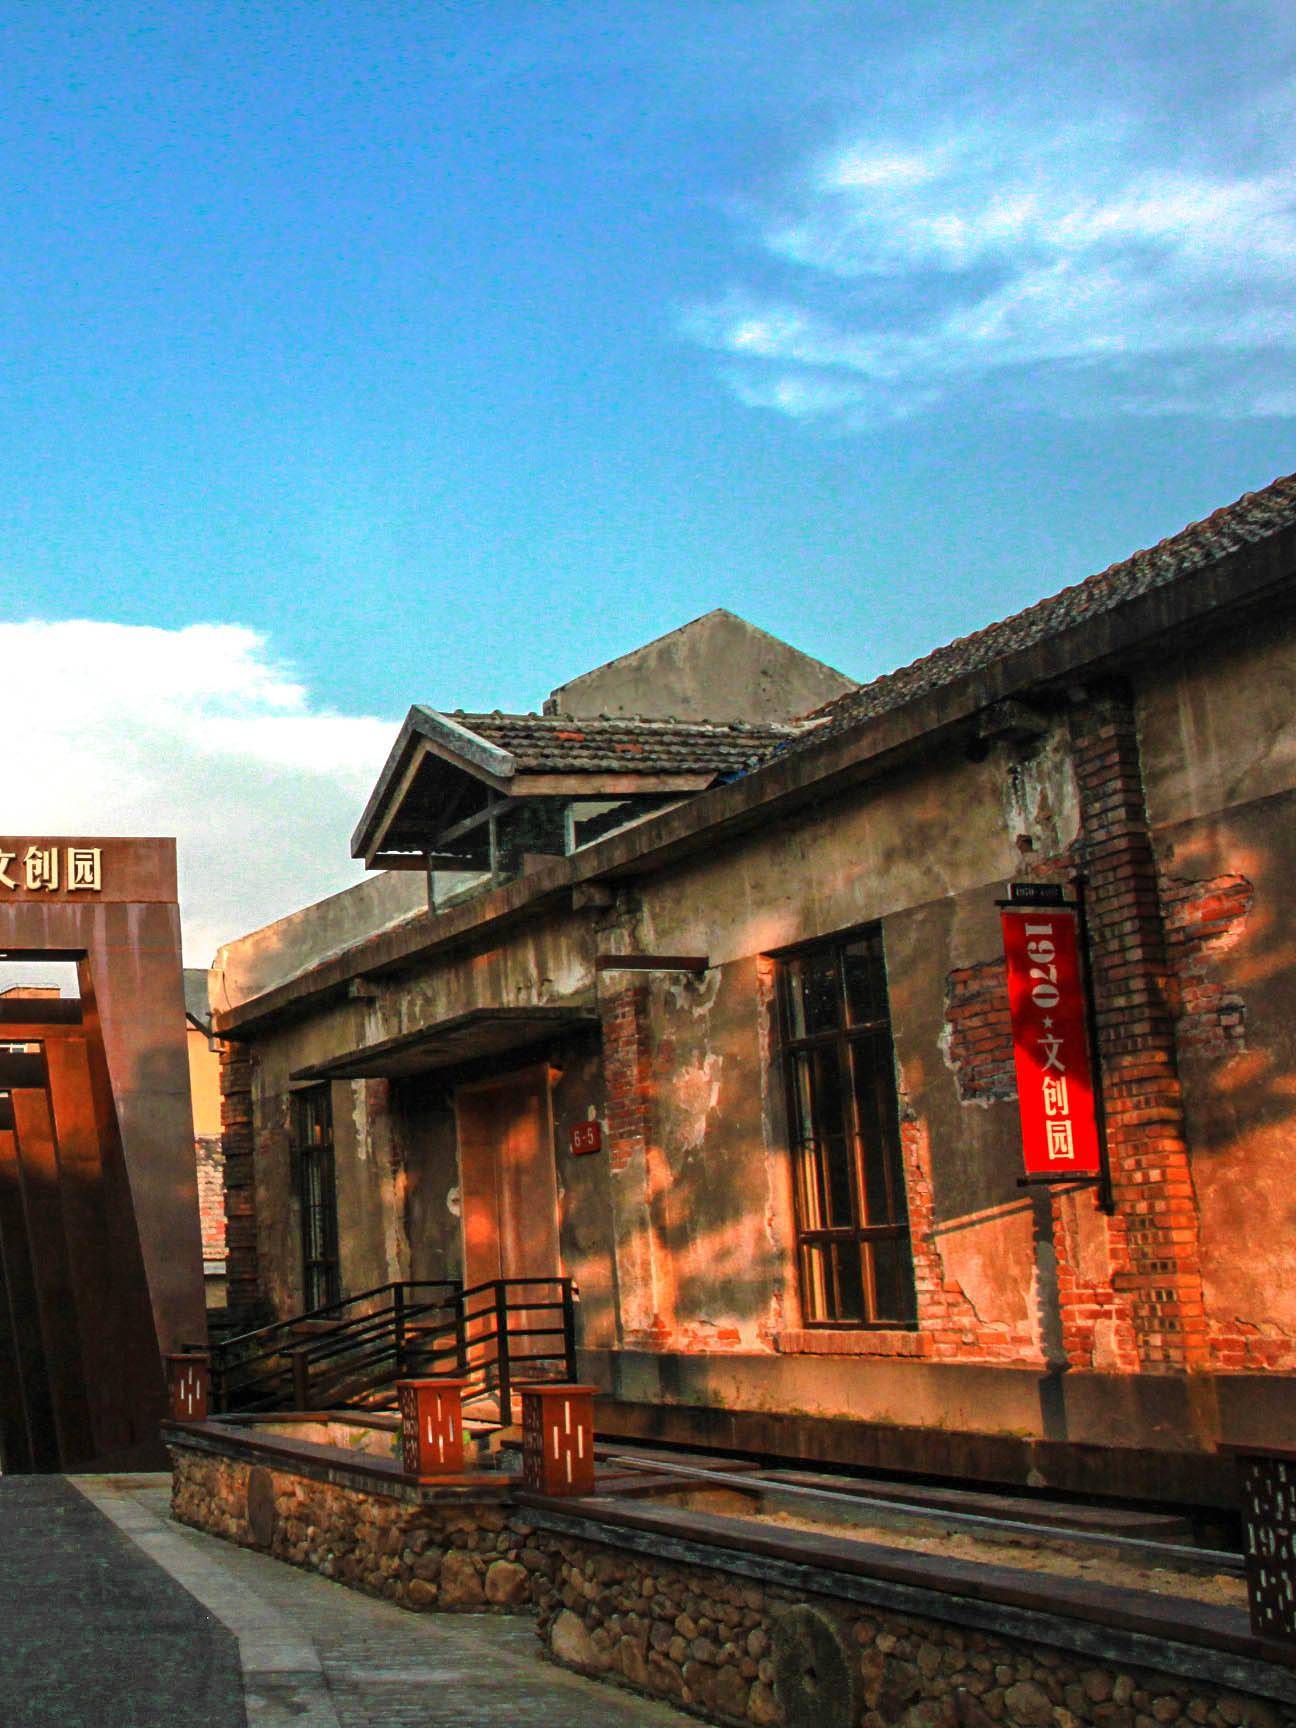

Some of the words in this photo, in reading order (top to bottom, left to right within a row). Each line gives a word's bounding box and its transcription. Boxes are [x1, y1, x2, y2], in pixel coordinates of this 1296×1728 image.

[1024, 922, 1060, 1009] 1970
[573, 1127, 594, 1148] 6-5
[1037, 1033, 1075, 1160] 文创园
